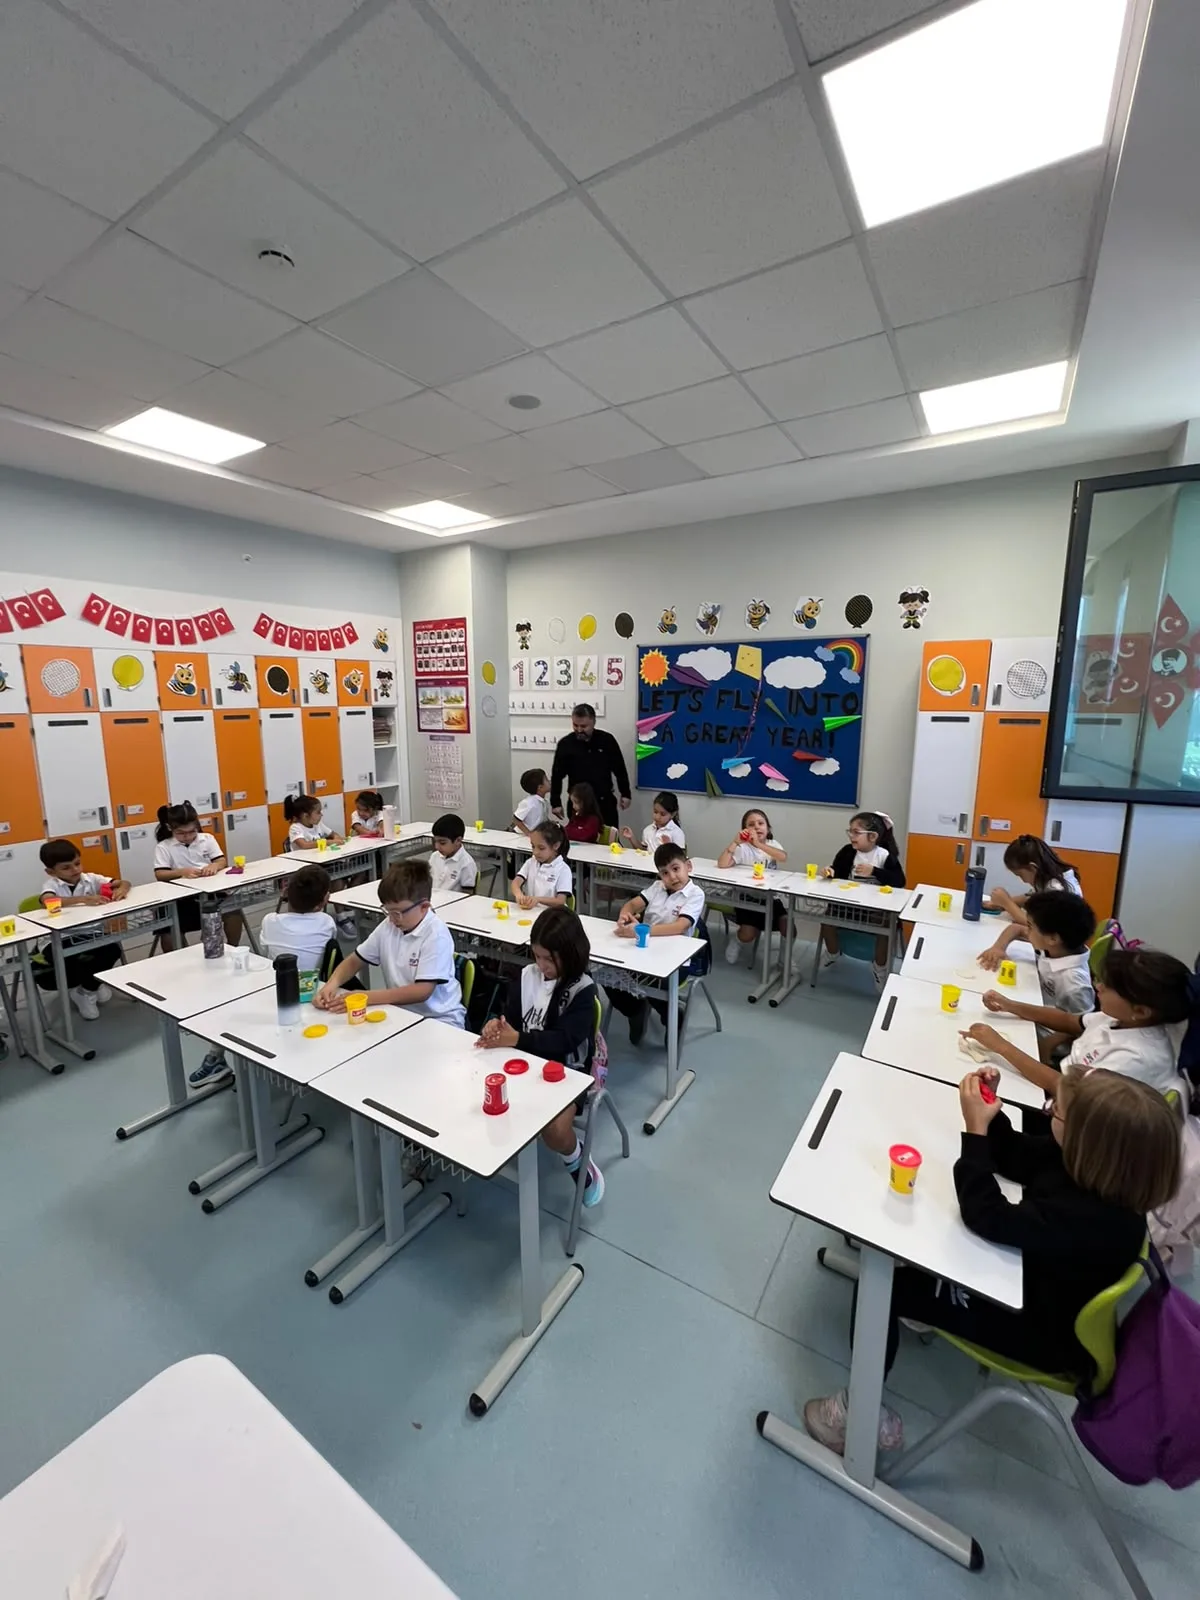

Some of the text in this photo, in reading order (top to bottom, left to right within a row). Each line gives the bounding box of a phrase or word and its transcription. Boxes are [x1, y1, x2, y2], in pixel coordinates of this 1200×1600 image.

[512, 657, 623, 687] 1 2 3 4 5
[640, 688, 860, 716] LET'S FLY INTO
[661, 722, 835, 755] A GREAT YEAR!
